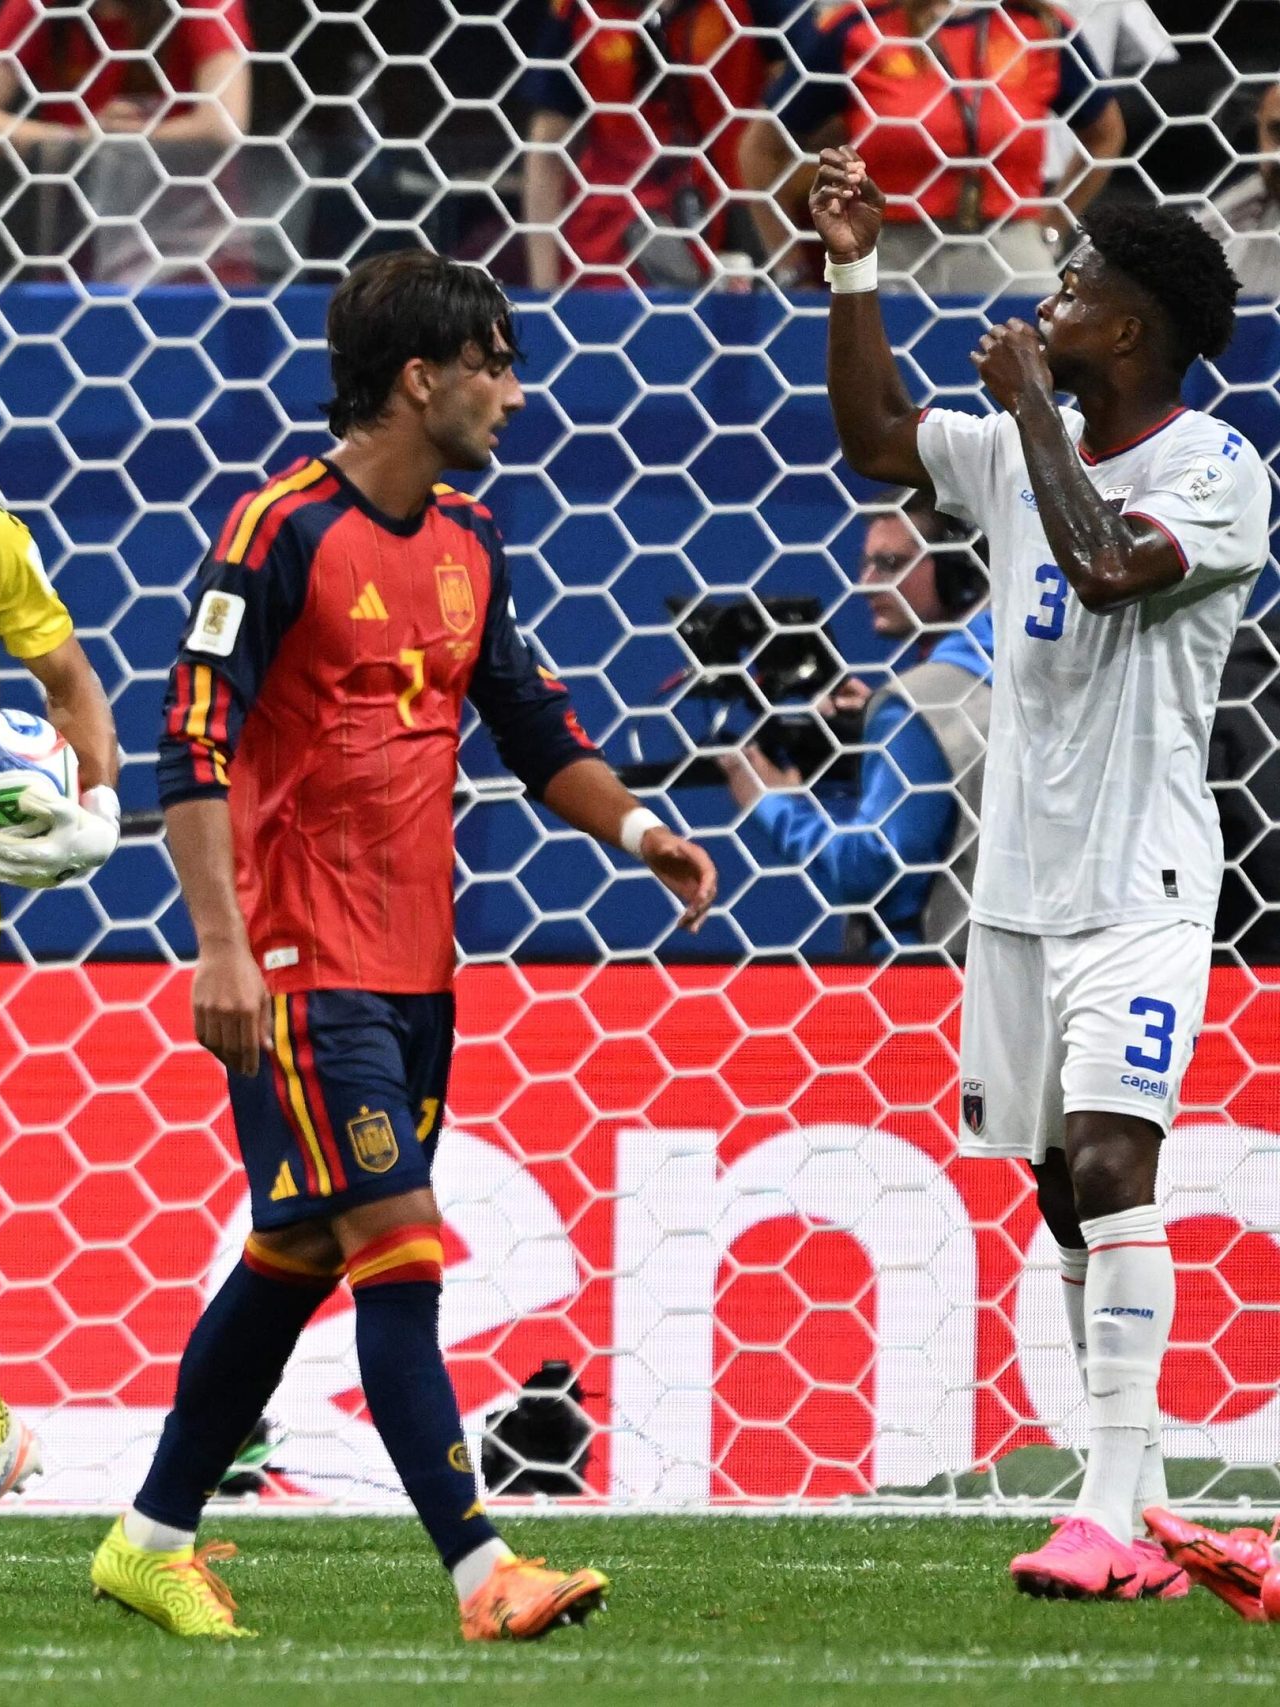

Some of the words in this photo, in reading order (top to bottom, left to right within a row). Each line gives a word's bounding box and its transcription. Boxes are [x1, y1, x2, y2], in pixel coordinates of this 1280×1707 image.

[1024, 563, 1069, 642] 3
[397, 648, 425, 729] 7
[1124, 995, 1177, 1074] 3
[1120, 1074, 1169, 1100] capelli
